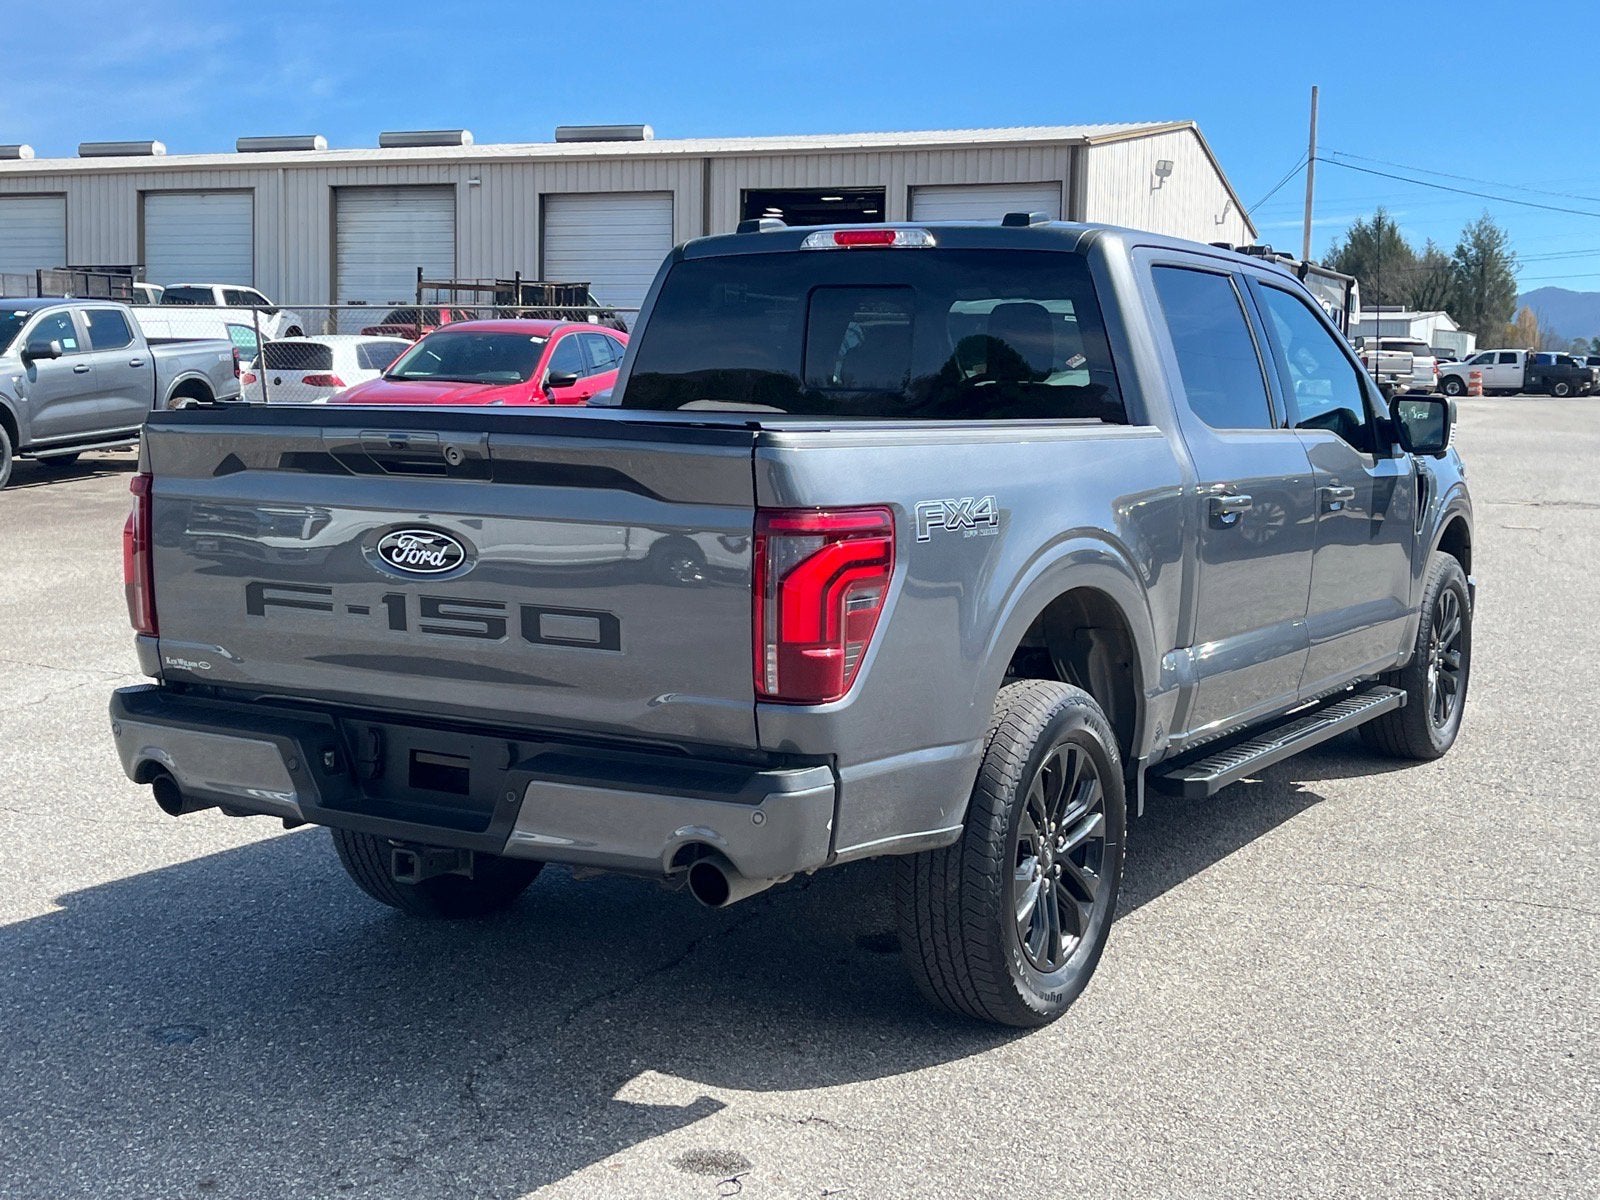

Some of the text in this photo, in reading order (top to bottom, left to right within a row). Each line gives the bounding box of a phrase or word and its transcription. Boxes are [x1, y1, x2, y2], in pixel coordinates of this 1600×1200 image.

[914, 495, 999, 543] FX4
[392, 535, 447, 566] Ford
[246, 581, 622, 652] F-150
